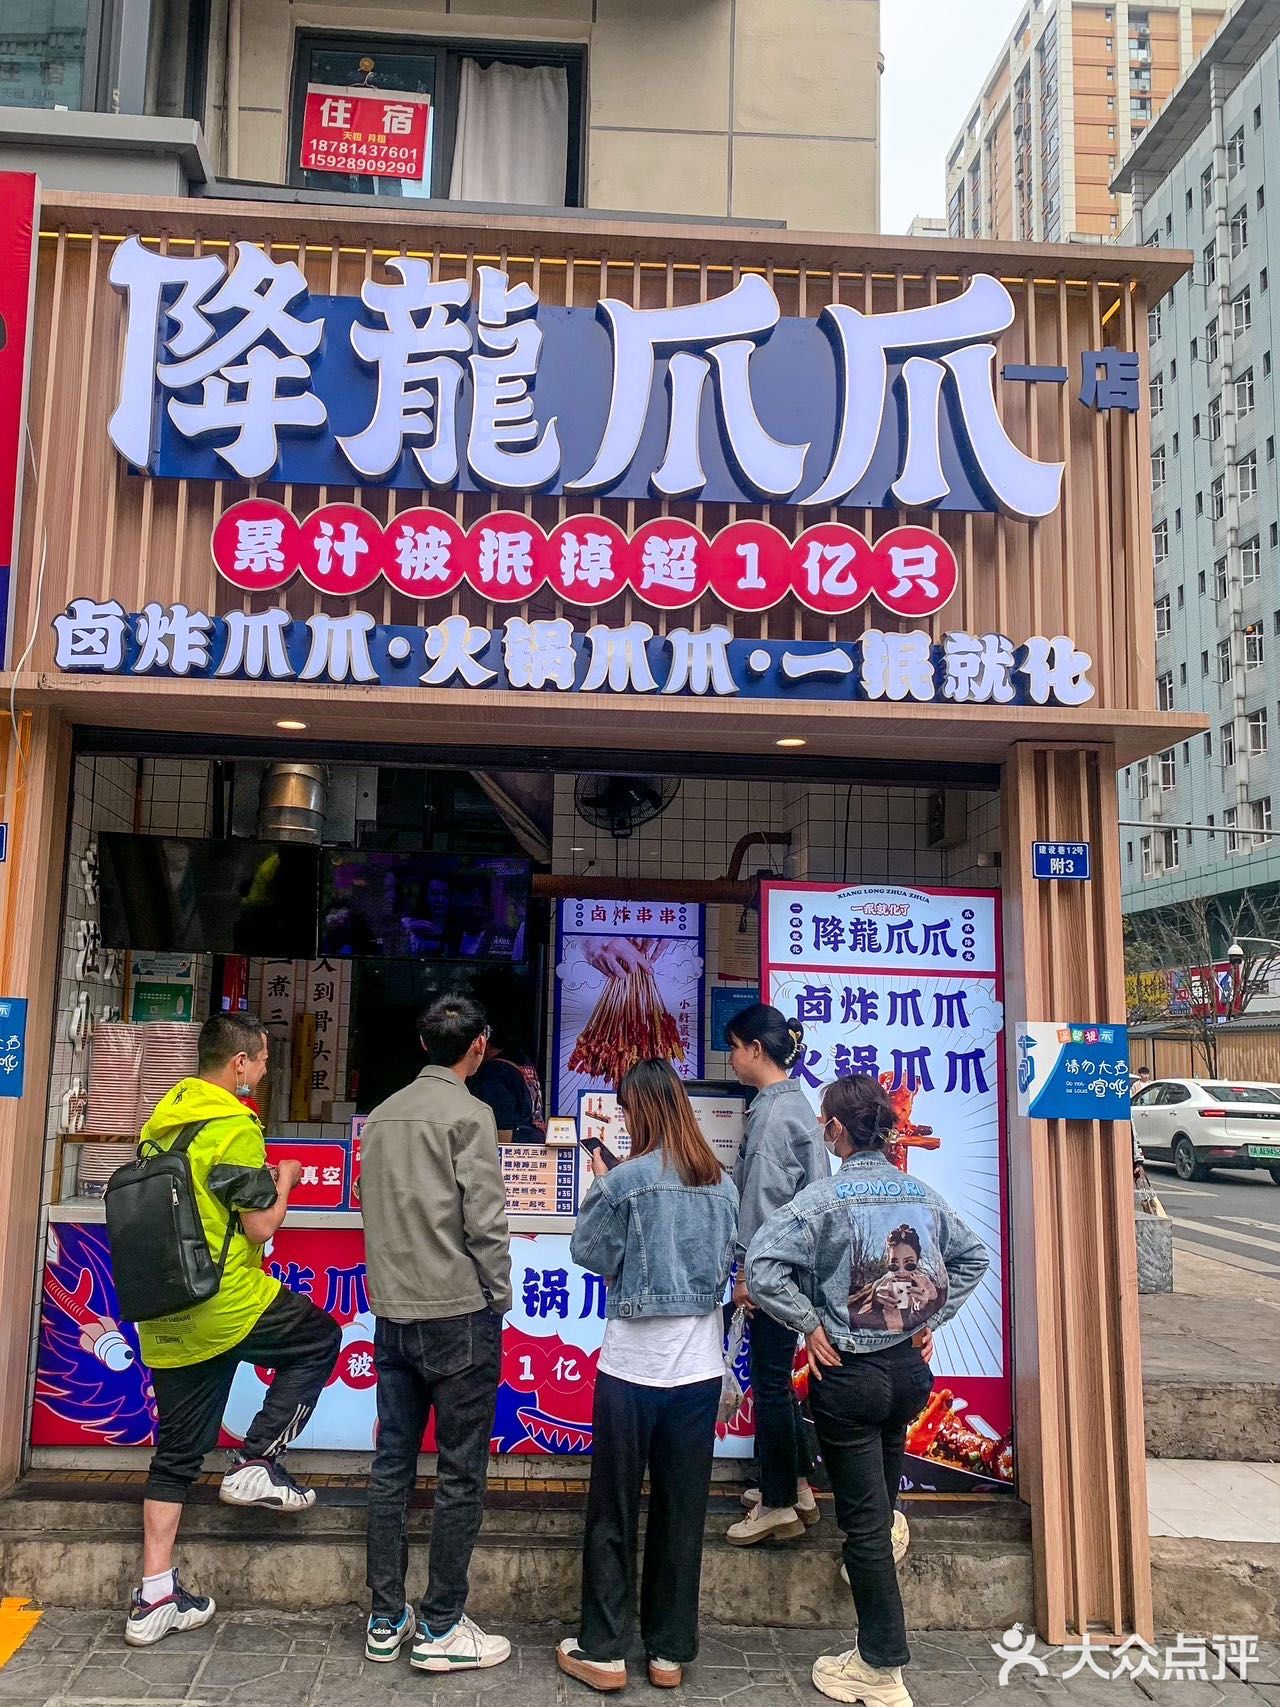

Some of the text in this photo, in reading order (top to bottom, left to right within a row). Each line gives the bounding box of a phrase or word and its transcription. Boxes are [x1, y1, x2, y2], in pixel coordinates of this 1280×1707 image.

[320, 98, 414, 134] 住宿
[343, 131, 386, 144] 天租 月租
[310, 139, 417, 159] 18781437601
[308, 154, 416, 174] 15928909290
[107, 236, 1065, 520] 降龍爪爪
[232, 517, 941, 599] 累计被抿掉超1亿只
[1050, 858, 1074, 874] 附3
[836, 889, 863, 900] XIANG
[886, 888, 908, 897] ZHUA
[908, 893, 930, 904] ZHUA
[591, 904, 676, 925] 卤炸串串
[811, 914, 958, 958] 降龍爪爪
[794, 984, 971, 1029] 卤炸爪爪
[1058, 1030, 1113, 1043] 温馨提示
[789, 1045, 990, 1094] 火锅爪爪
[1065, 1059, 1129, 1076] 请勿大声
[1087, 1078, 1129, 1099] 喧哗
[300, 1165, 341, 1186] 真空
[346, 1351, 582, 1382] 被 1亿
[372, 1627, 392, 1635] adidas
